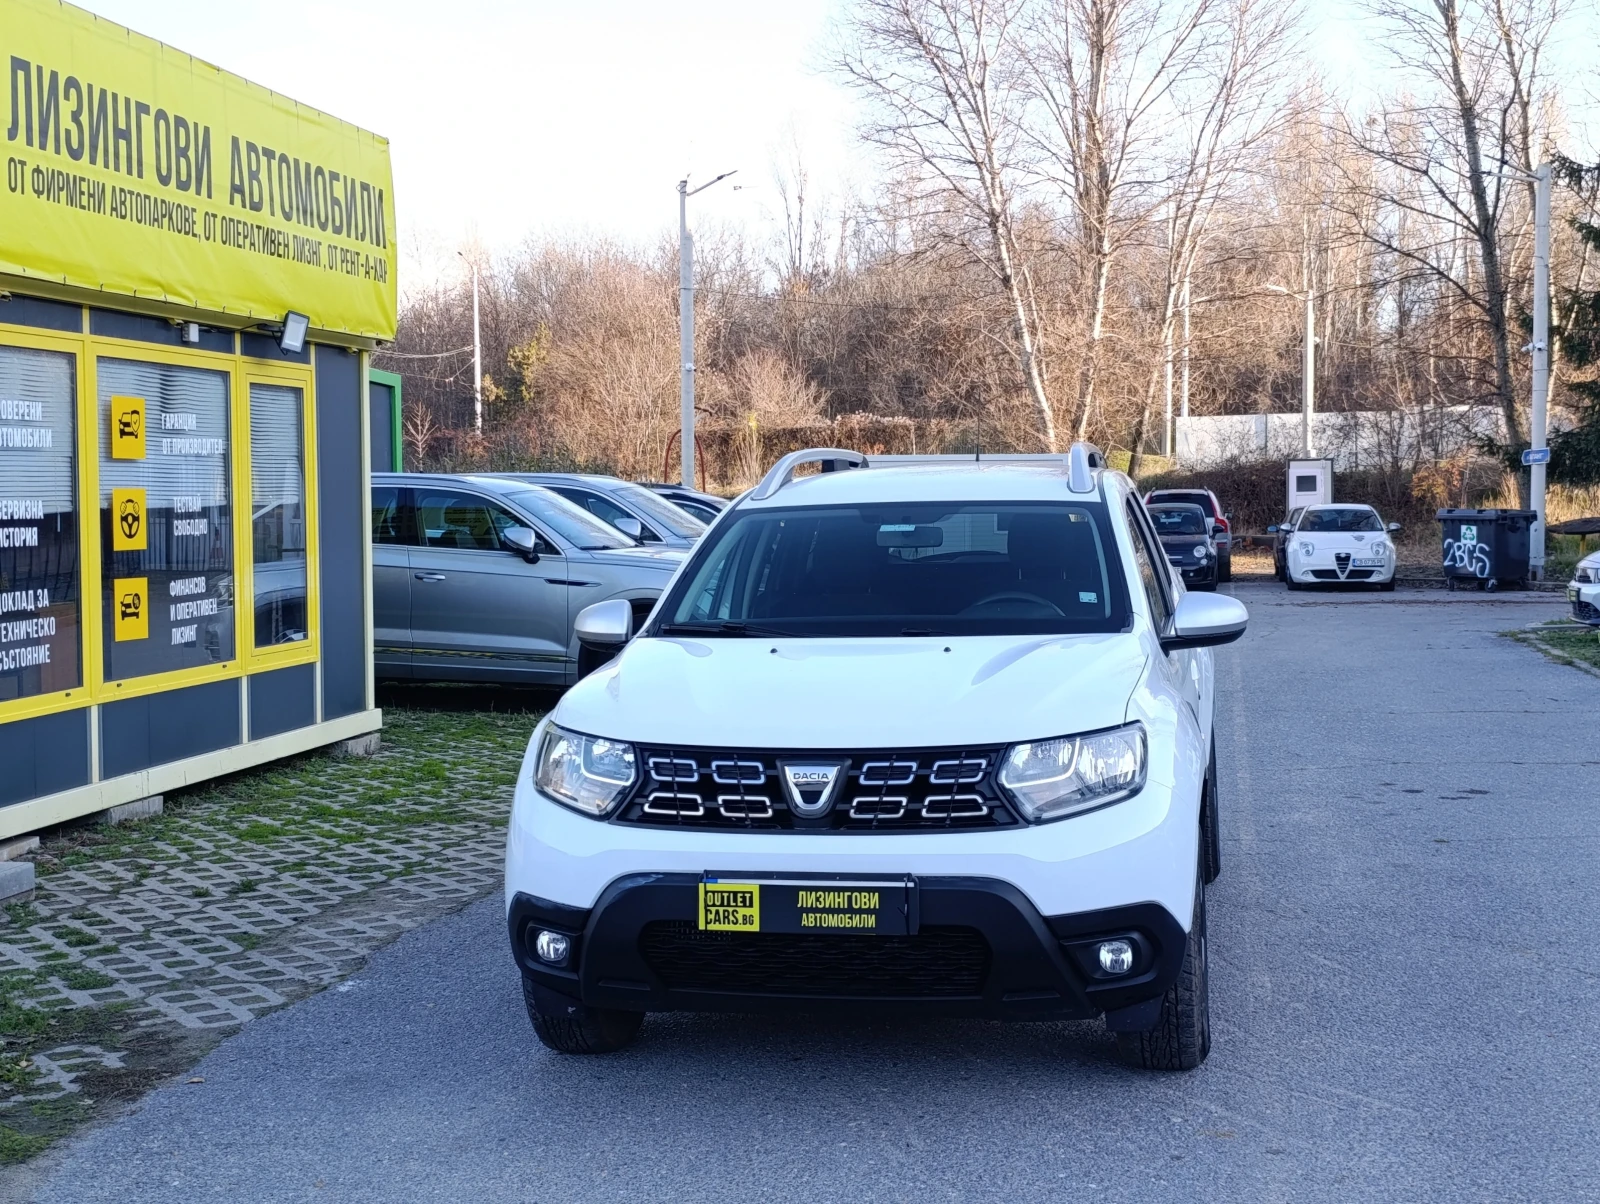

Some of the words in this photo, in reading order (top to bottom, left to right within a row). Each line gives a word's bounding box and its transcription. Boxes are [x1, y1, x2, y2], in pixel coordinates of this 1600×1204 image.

[8, 55, 213, 200] ЛИЗИНГОВИ
[229, 135, 387, 249] АВТОМОБИЛИ
[8, 157, 27, 195] ОТ
[31, 164, 106, 216] ФИРМЕНИ
[110, 185, 201, 243] АВТОПАРКОВЕ,
[204, 211, 218, 243] ОТ
[220, 215, 290, 260] ОПЕРАТИВЕН
[327, 243, 338, 272] ОТ
[0, 399, 42, 421] ОВЕРЕНИ
[161, 413, 197, 431] ГАРАНЦИЯ
[162, 438, 171, 454] ОТ
[172, 438, 223, 456] ПРОИЗВОДИТЕЛ
[173, 493, 202, 513] ТЕСТВАЙ
[173, 518, 208, 537] СВОБОДНО
[169, 576, 207, 597] ФИНАНСОВ
[37, 588, 50, 608] ЗА
[170, 604, 176, 622] И
[176, 598, 218, 621] ОПЕРАТИВЕН
[0, 616, 56, 643] ЕХНИЧЕСКО
[171, 624, 198, 646] ЛИЗИНГ
[793, 772, 829, 780] DACIA
[706, 892, 752, 907] OUTLET
[797, 891, 879, 909] ЛИЗИНГОВИ
[705, 908, 754, 926] CARS.BG
[801, 912, 876, 928] АВТОМОБИЛИ
